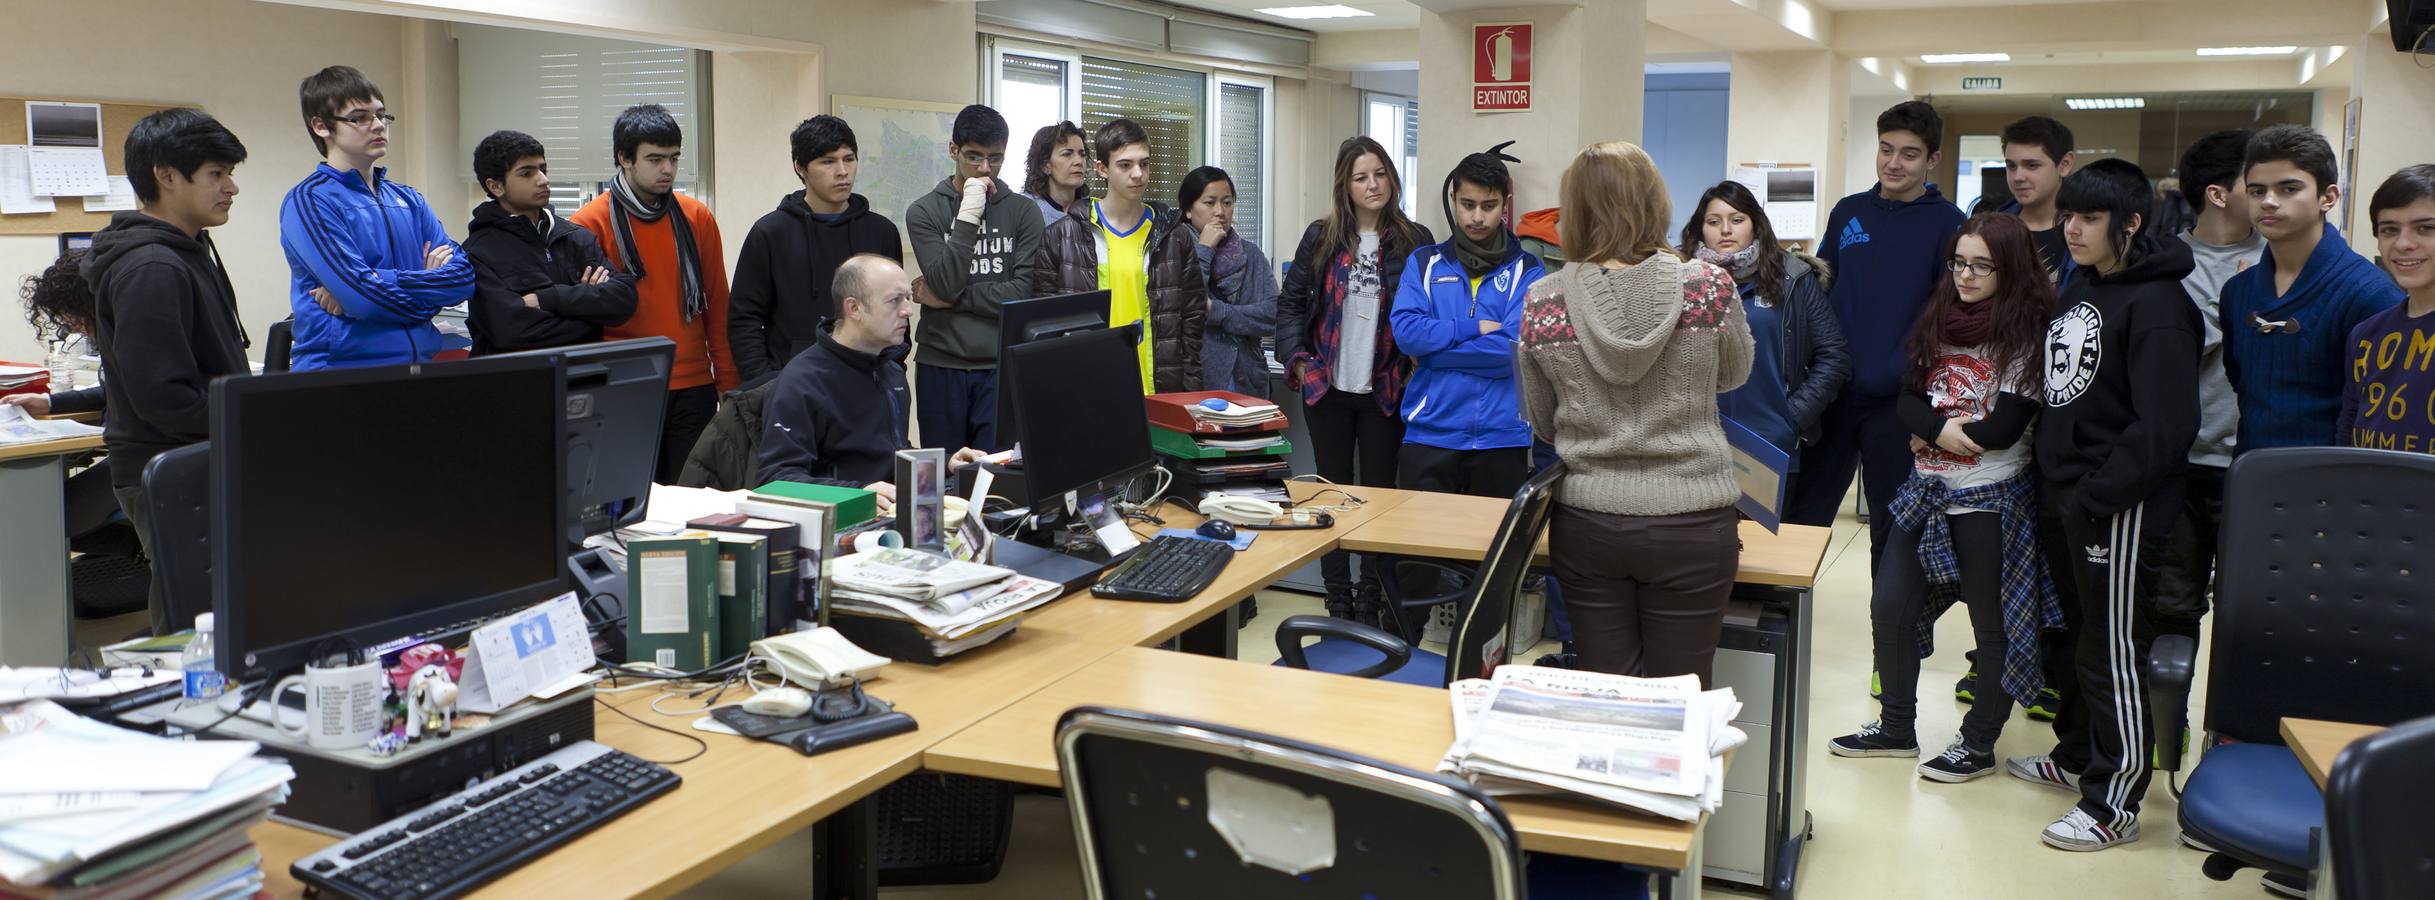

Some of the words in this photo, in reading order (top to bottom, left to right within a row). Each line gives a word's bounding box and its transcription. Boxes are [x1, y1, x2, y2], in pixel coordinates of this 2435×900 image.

[1964, 79, 2000, 89] SALIDA
[1477, 90, 1528, 105] EXTINTOR
[1840, 232, 1871, 249] adidas
[2078, 306, 2099, 351] NIGHT
[2056, 365, 2093, 404] PRIDE
[2087, 556, 2109, 564] adidas
[1546, 681, 1622, 695] RIOJA
